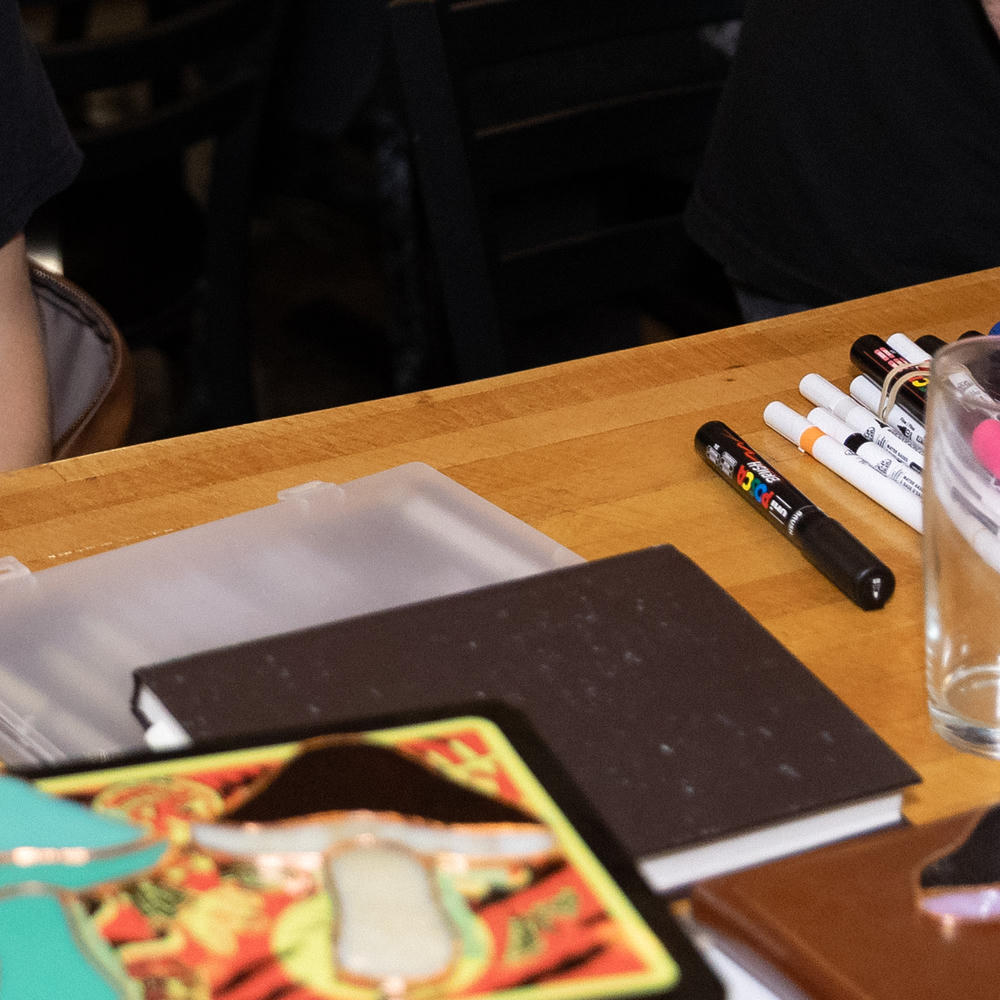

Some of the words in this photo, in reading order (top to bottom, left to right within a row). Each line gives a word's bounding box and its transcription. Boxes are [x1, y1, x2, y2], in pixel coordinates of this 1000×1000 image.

[747, 461, 780, 483] BRUSH
[737, 465, 775, 509] POSCA
[769, 500, 788, 518] uni
